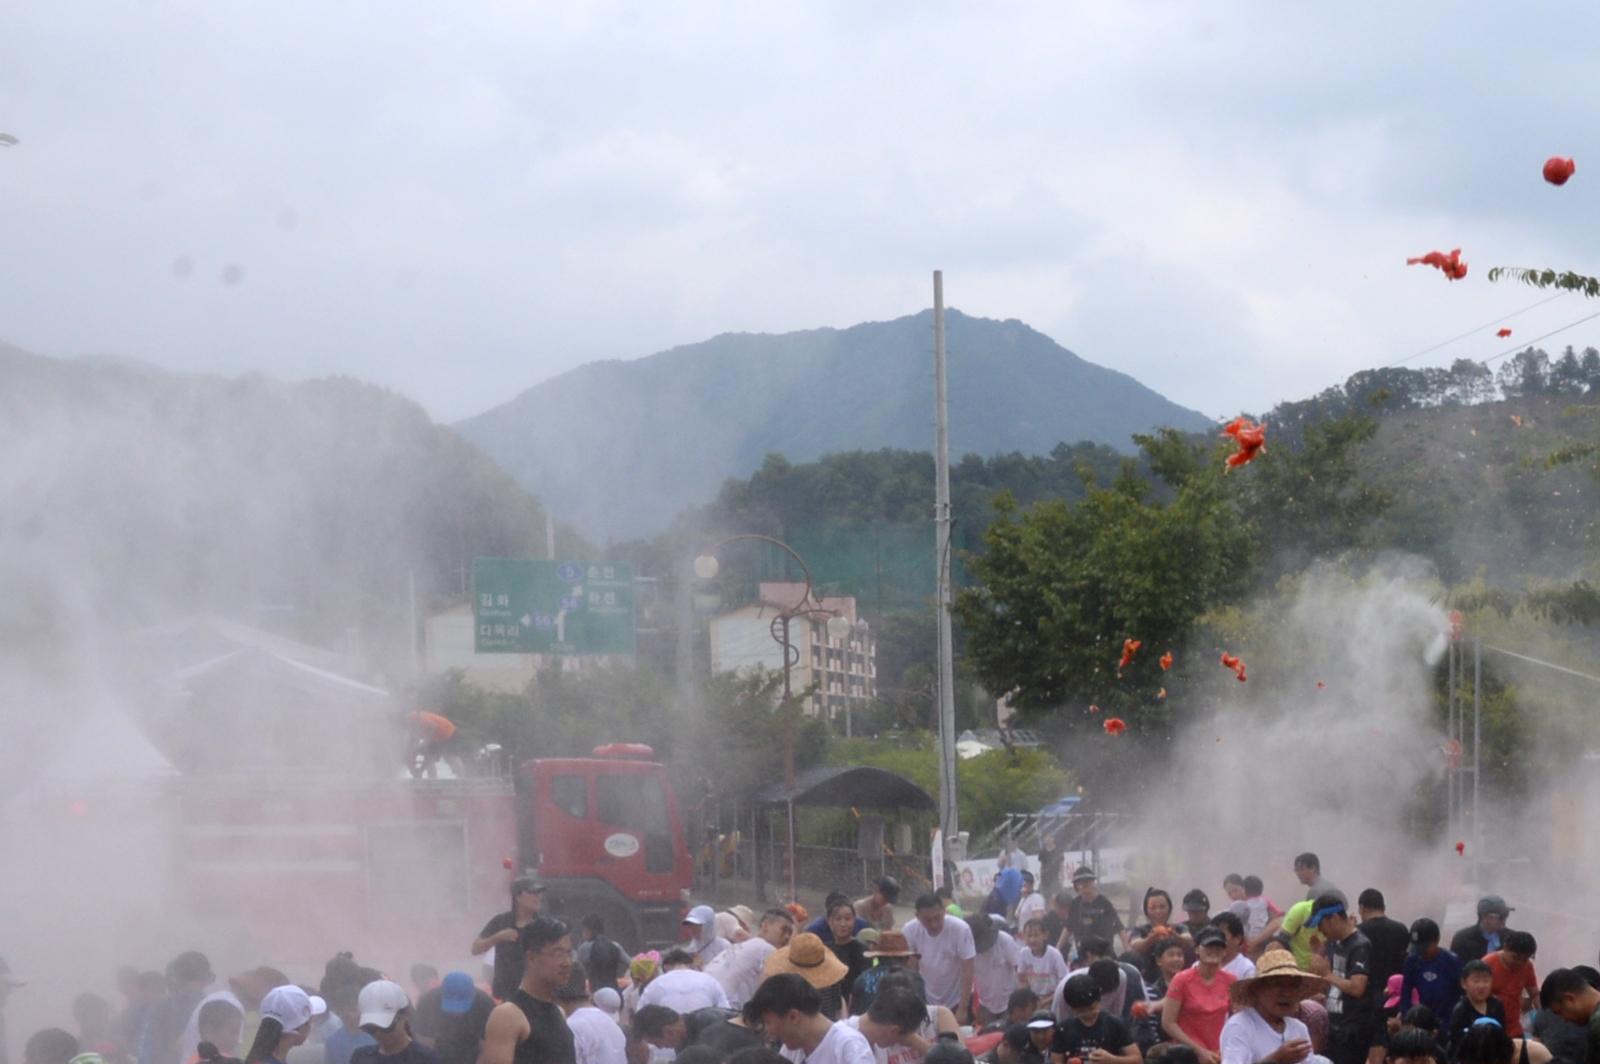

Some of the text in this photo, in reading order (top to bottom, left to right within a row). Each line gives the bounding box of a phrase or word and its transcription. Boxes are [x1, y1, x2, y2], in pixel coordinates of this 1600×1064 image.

[587, 565, 614, 579] 춘천
[480, 592, 510, 608] 김화
[589, 591, 616, 605] 화천
